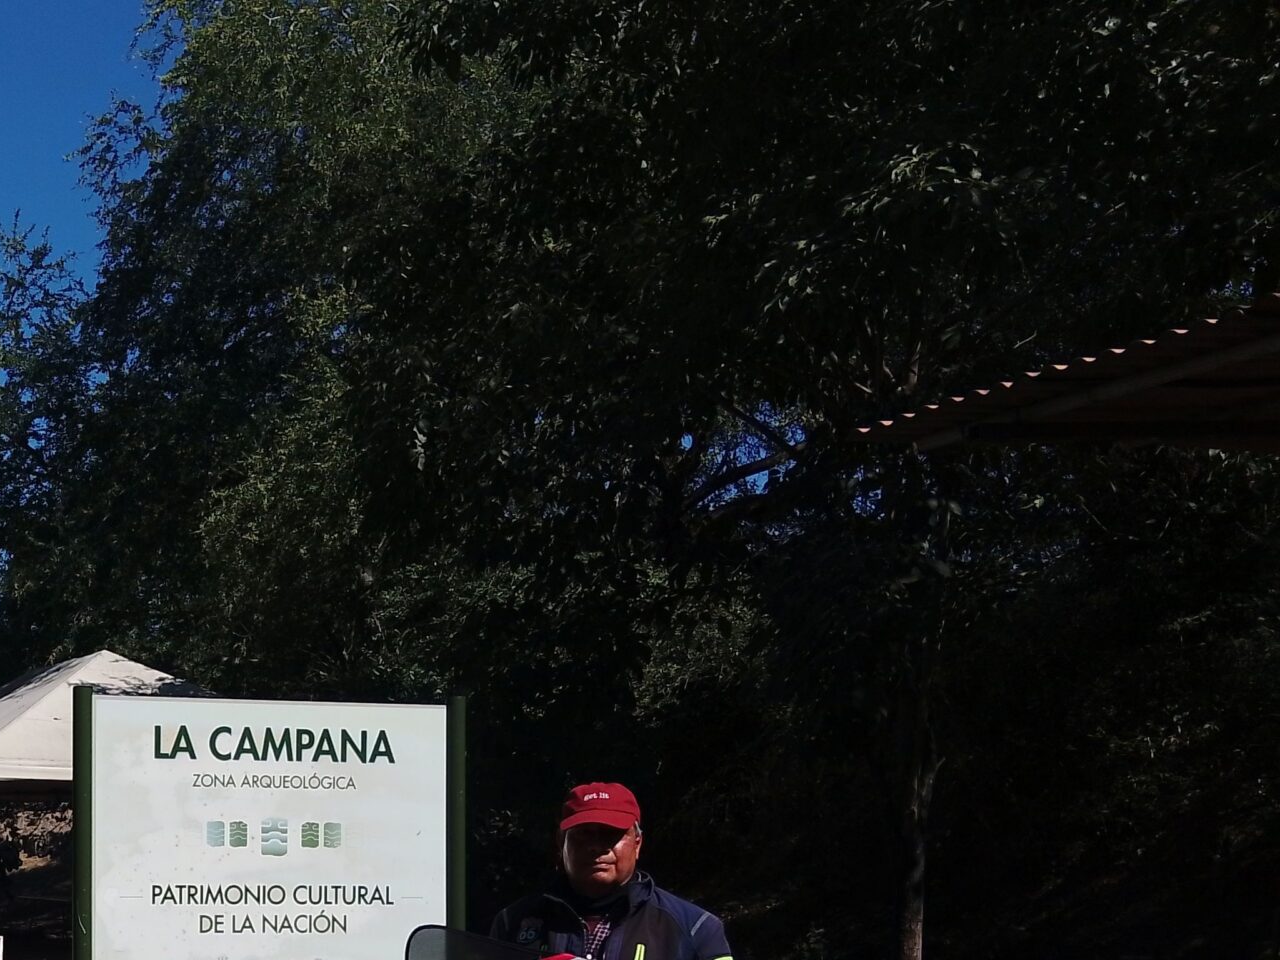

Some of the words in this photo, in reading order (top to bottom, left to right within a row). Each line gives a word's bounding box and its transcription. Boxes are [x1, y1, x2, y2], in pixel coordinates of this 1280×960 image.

[153, 725, 197, 760] LA
[208, 726, 396, 764] CAMPANA
[192, 773, 237, 789] ZONA
[241, 772, 357, 790] ARQUEOLÓGICA
[151, 884, 286, 905] PATRIMONIO
[293, 885, 395, 906] CULTURAL
[199, 914, 224, 933] DE
[232, 914, 256, 933] LA
[261, 910, 348, 934] NACIÓN
